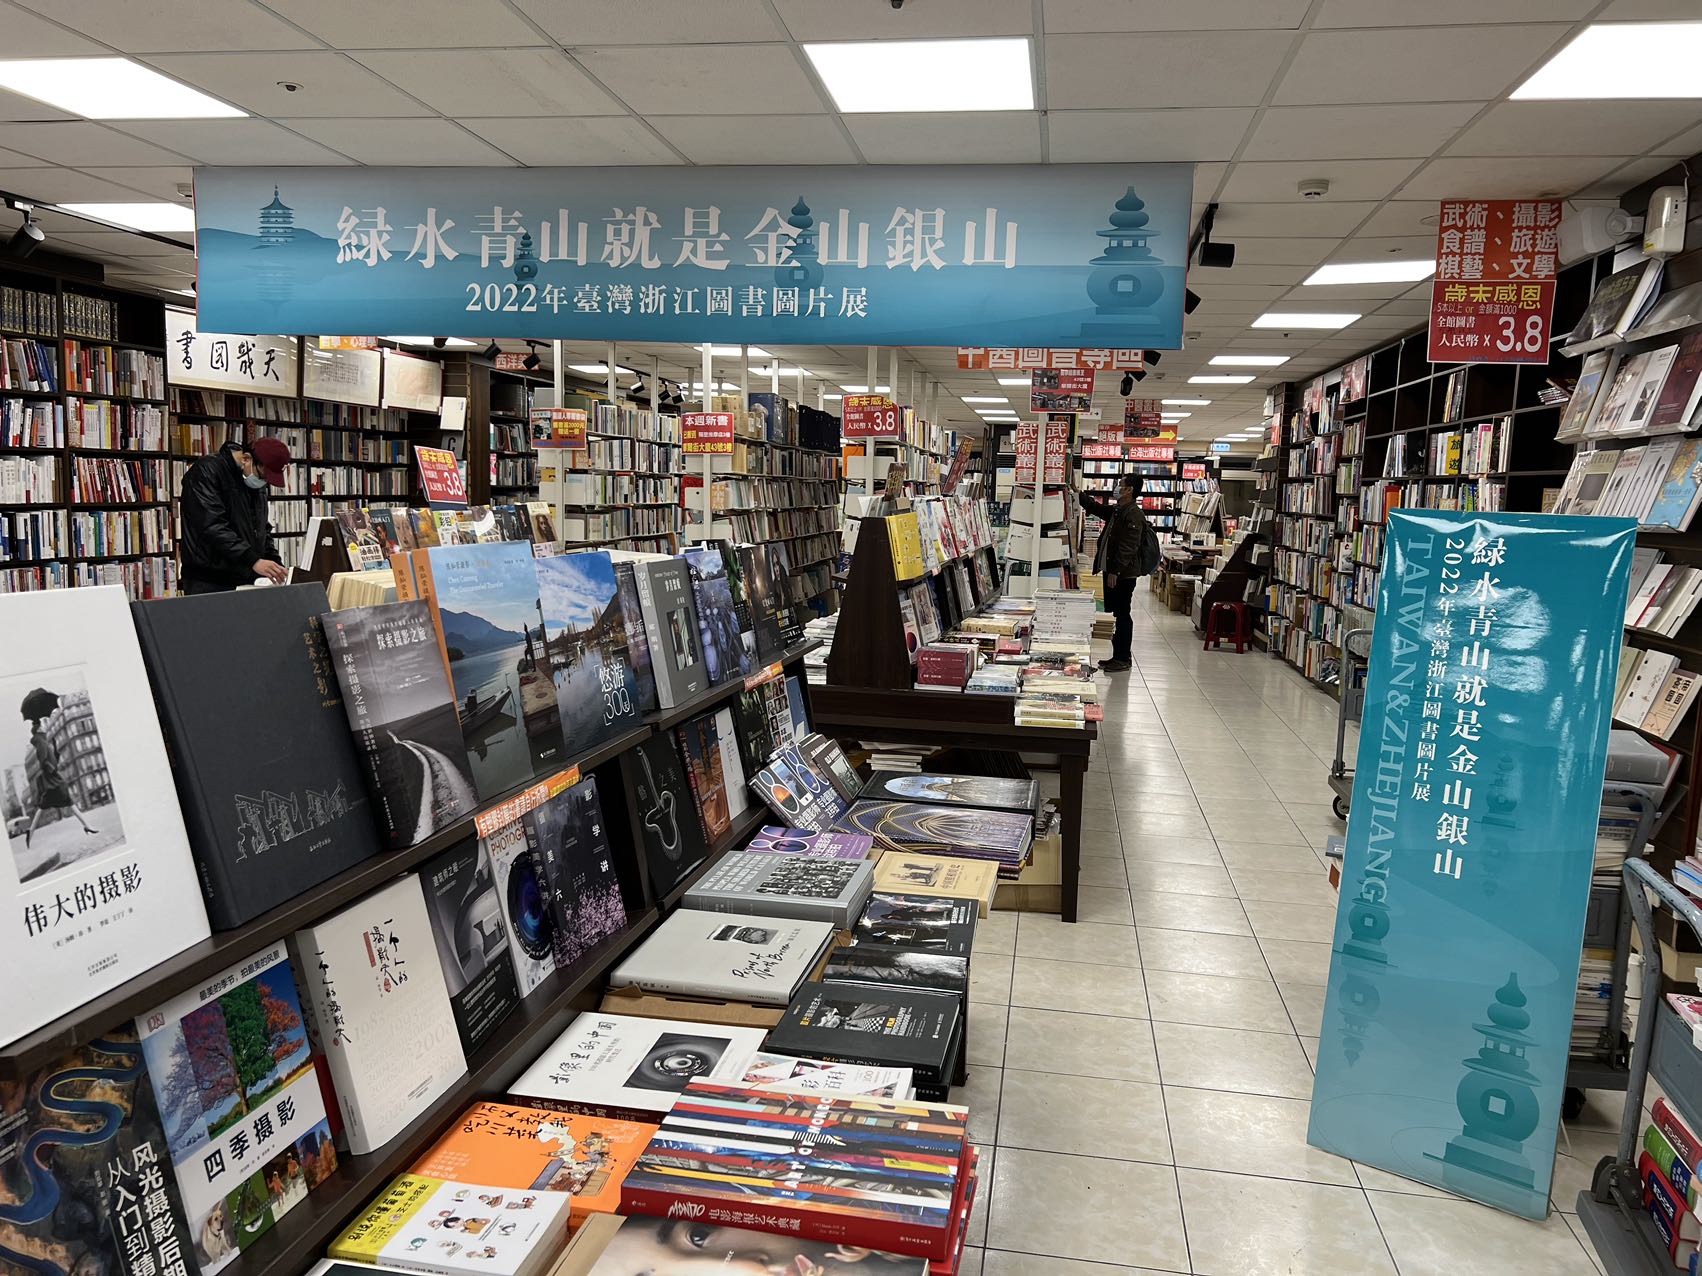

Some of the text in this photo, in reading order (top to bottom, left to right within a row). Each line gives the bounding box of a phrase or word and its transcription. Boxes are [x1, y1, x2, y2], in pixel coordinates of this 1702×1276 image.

[465, 282, 868, 318] 2022年臺灣浙江圖書圖片展
[1496, 315, 1543, 353] 3.8
[873, 411, 895, 431] 3.8
[443, 471, 463, 496] 3.8
[24, 862, 142, 938] 伟大的摄影
[203, 1095, 296, 1184] 四季摄影
